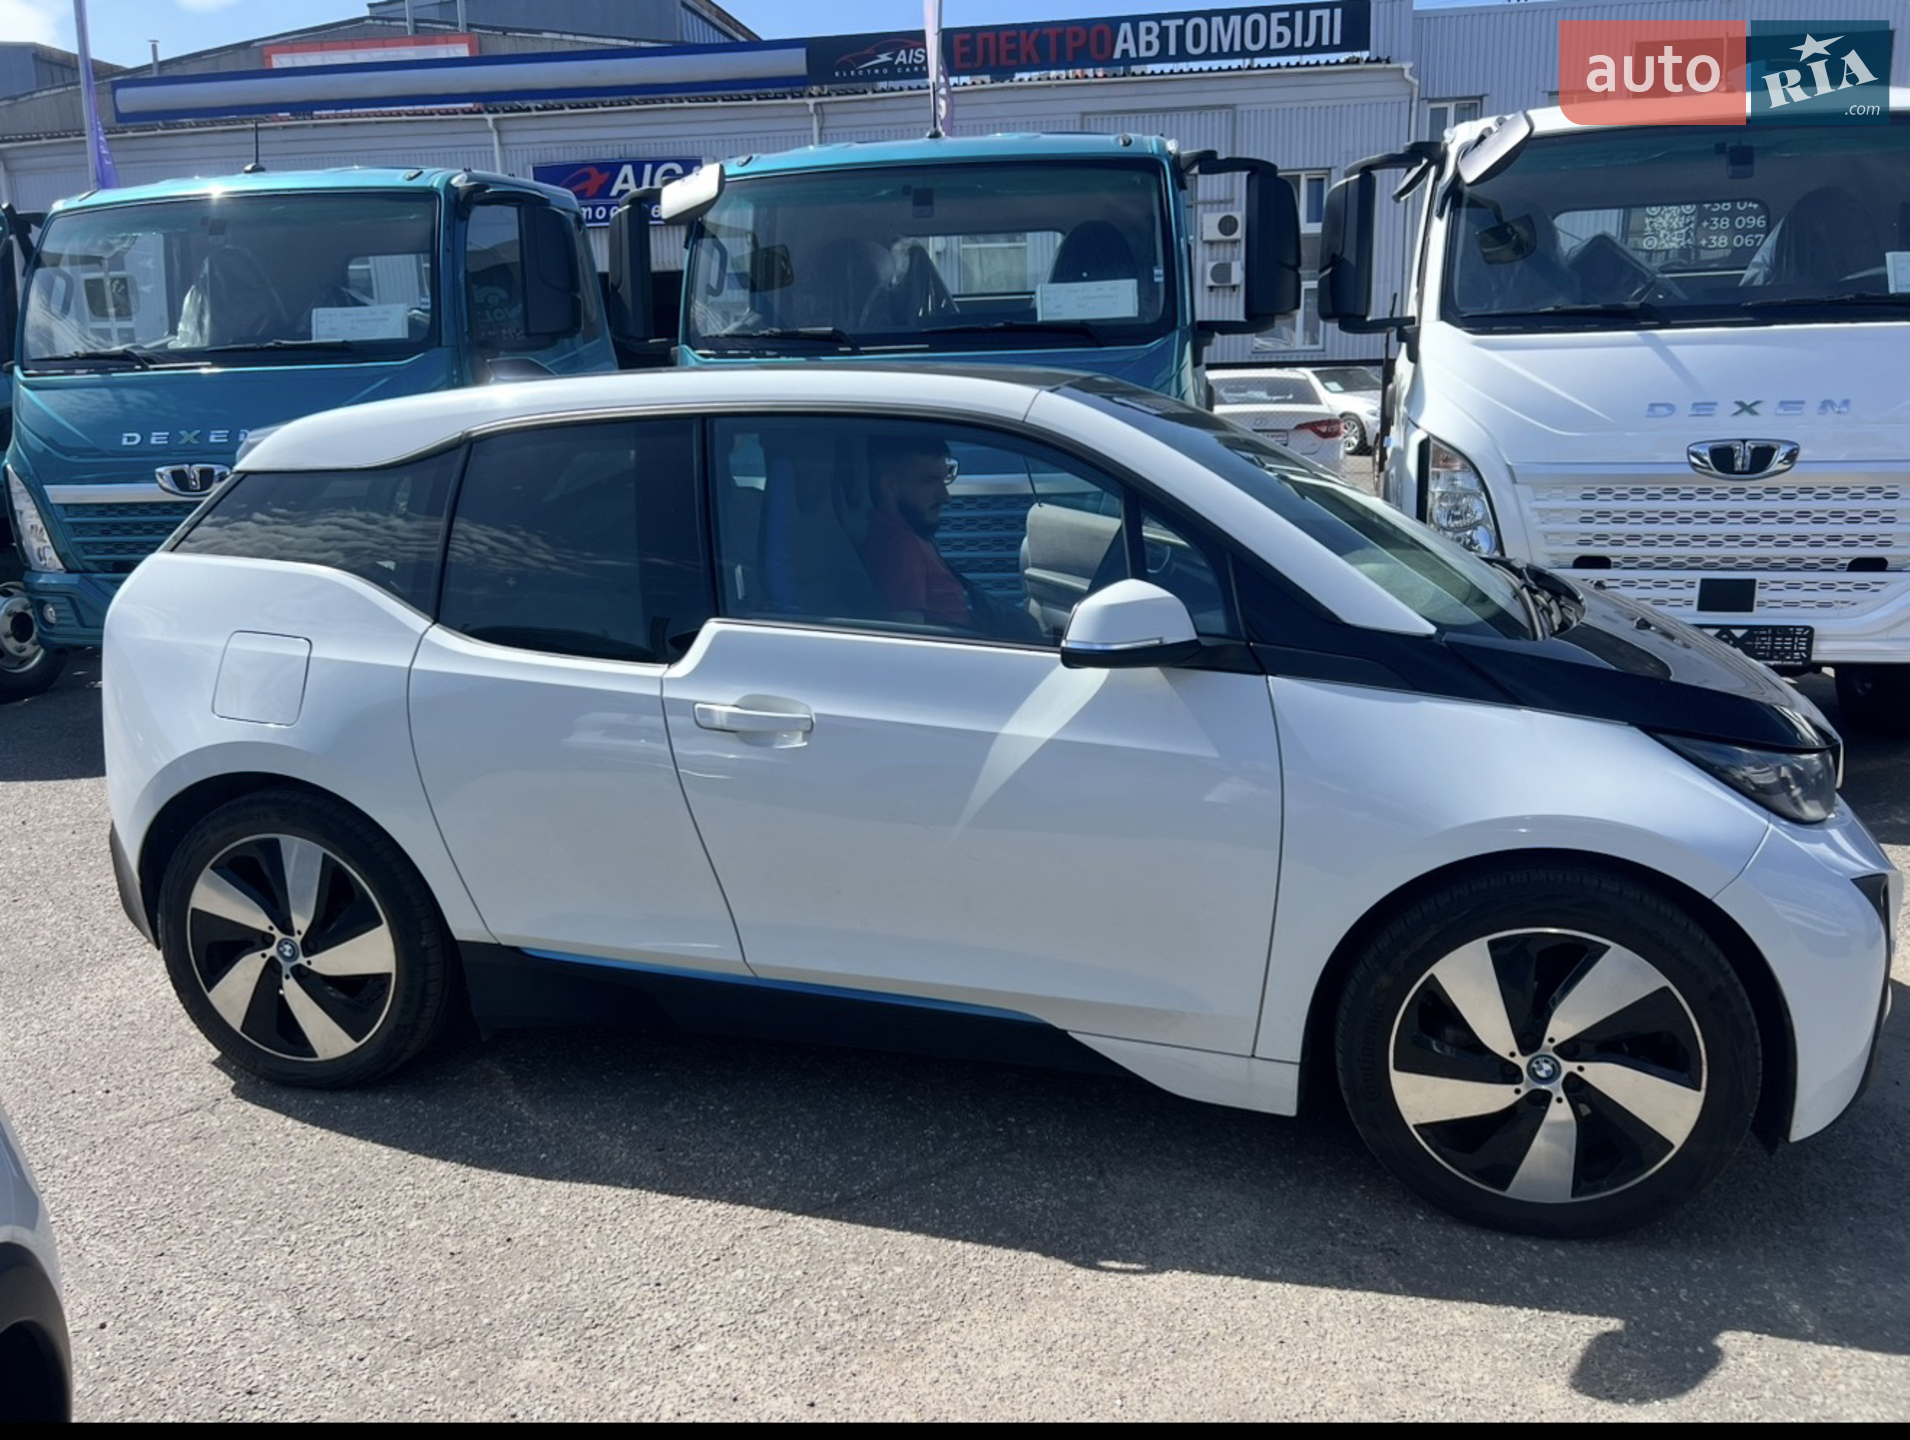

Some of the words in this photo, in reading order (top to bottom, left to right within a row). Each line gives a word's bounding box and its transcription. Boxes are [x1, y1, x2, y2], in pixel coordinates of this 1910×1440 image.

[953, 8, 1342, 69] ЕЛЕКТРОАВТОМОБІЛІ
[894, 48, 926, 66] AIS
[834, 68, 889, 77] ELECTRO
[1702, 217, 1730, 229] +38
[1735, 216, 1765, 228] 096
[1701, 235, 1728, 247] +38
[1734, 234, 1764, 246] 067
[1645, 398, 1851, 418] DEXEN
